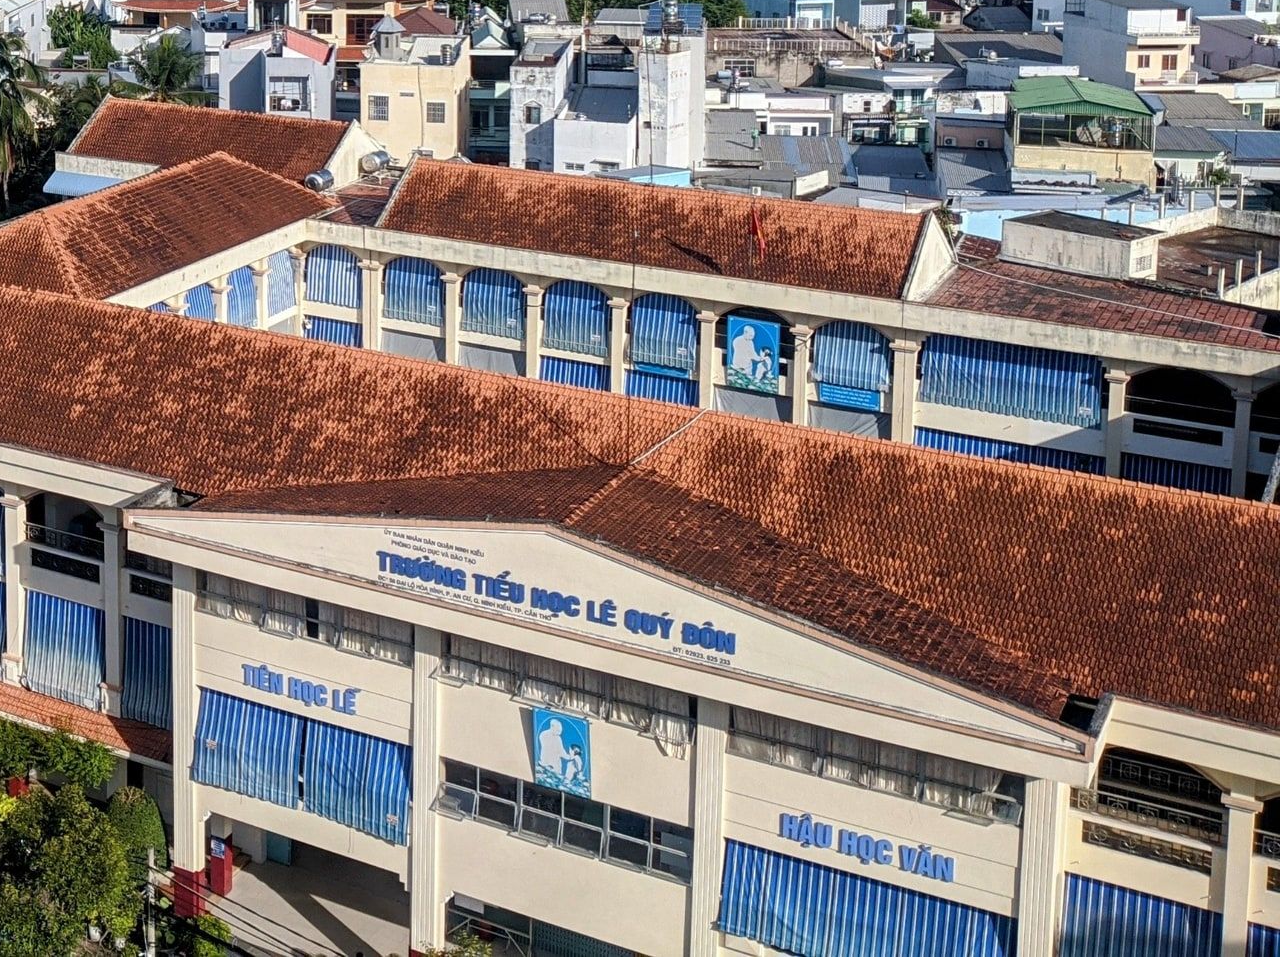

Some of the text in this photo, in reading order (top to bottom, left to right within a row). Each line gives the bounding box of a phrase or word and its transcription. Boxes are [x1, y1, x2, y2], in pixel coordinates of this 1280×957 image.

[391, 539, 411, 549] PHÒNG
[412, 544, 427, 553] GIÁO
[427, 548, 440, 556] DỤC
[441, 550, 449, 558] VÀ
[393, 531, 404, 539] BAN
[406, 534, 422, 543] NHÂN
[423, 538, 435, 546] DÂN
[437, 542, 453, 552] QUẬN
[454, 545, 469, 553] NINH
[376, 550, 736, 655] TRƯỜNG TIỂU HỌC LÊ QUÝ ĐÔN
[407, 582, 415, 590] LỘ
[241, 663, 283, 695] TIÊN
[287, 676, 327, 707] HỌC
[777, 812, 954, 883] HẬU HỌC VĂN
